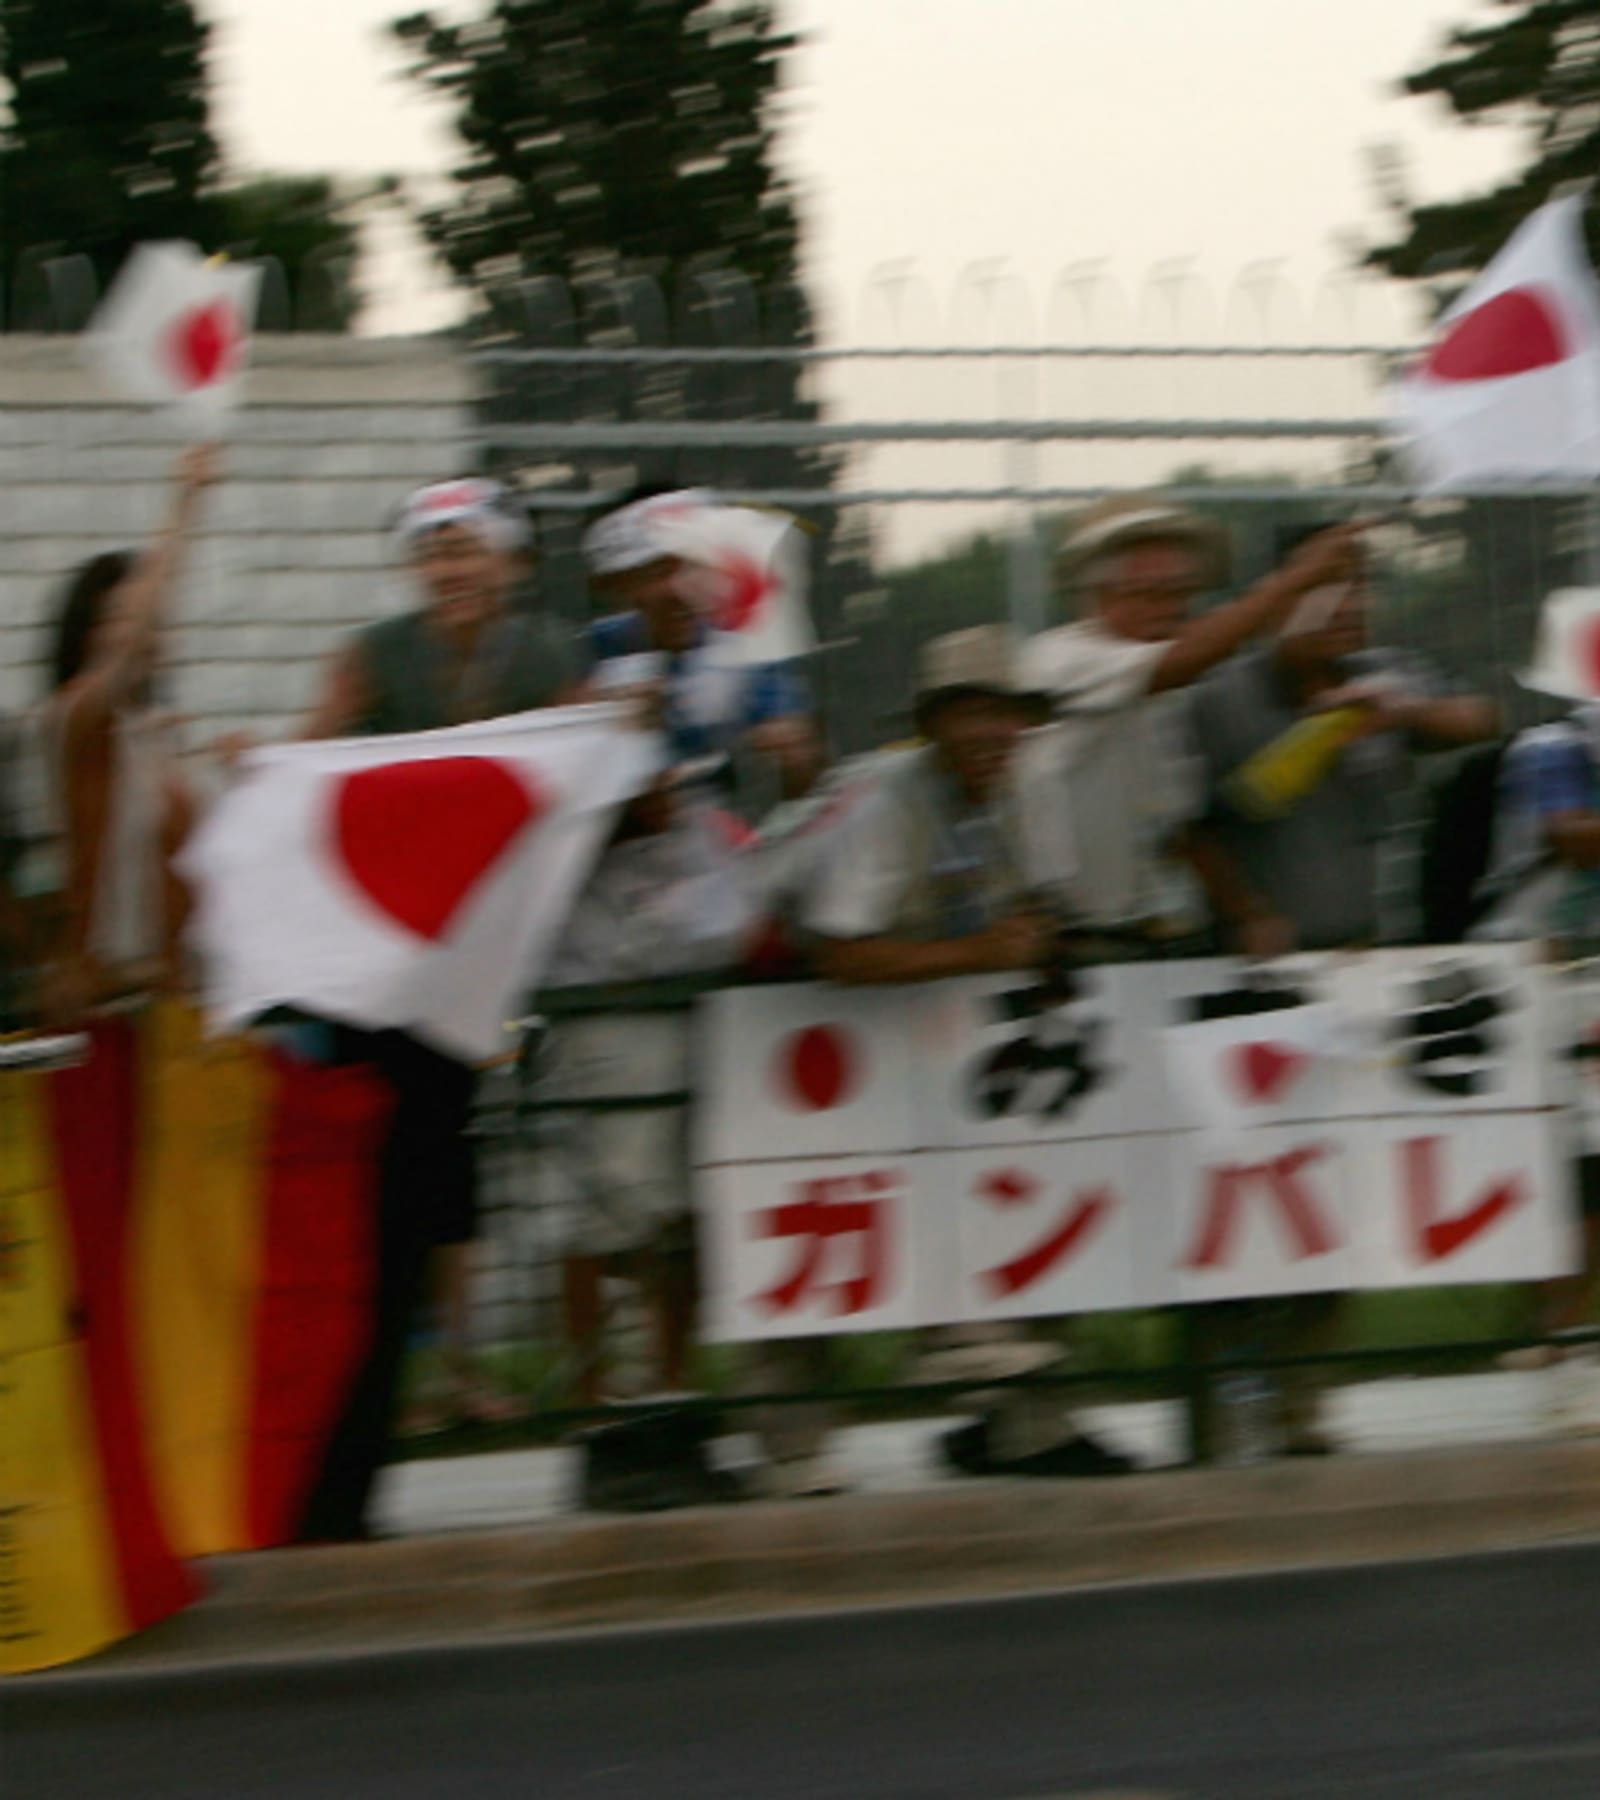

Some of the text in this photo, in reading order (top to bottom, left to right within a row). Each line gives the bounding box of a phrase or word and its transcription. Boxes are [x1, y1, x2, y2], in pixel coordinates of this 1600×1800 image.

[968, 956, 1522, 1124] みき
[750, 1134, 1533, 1318] ガンバレ
